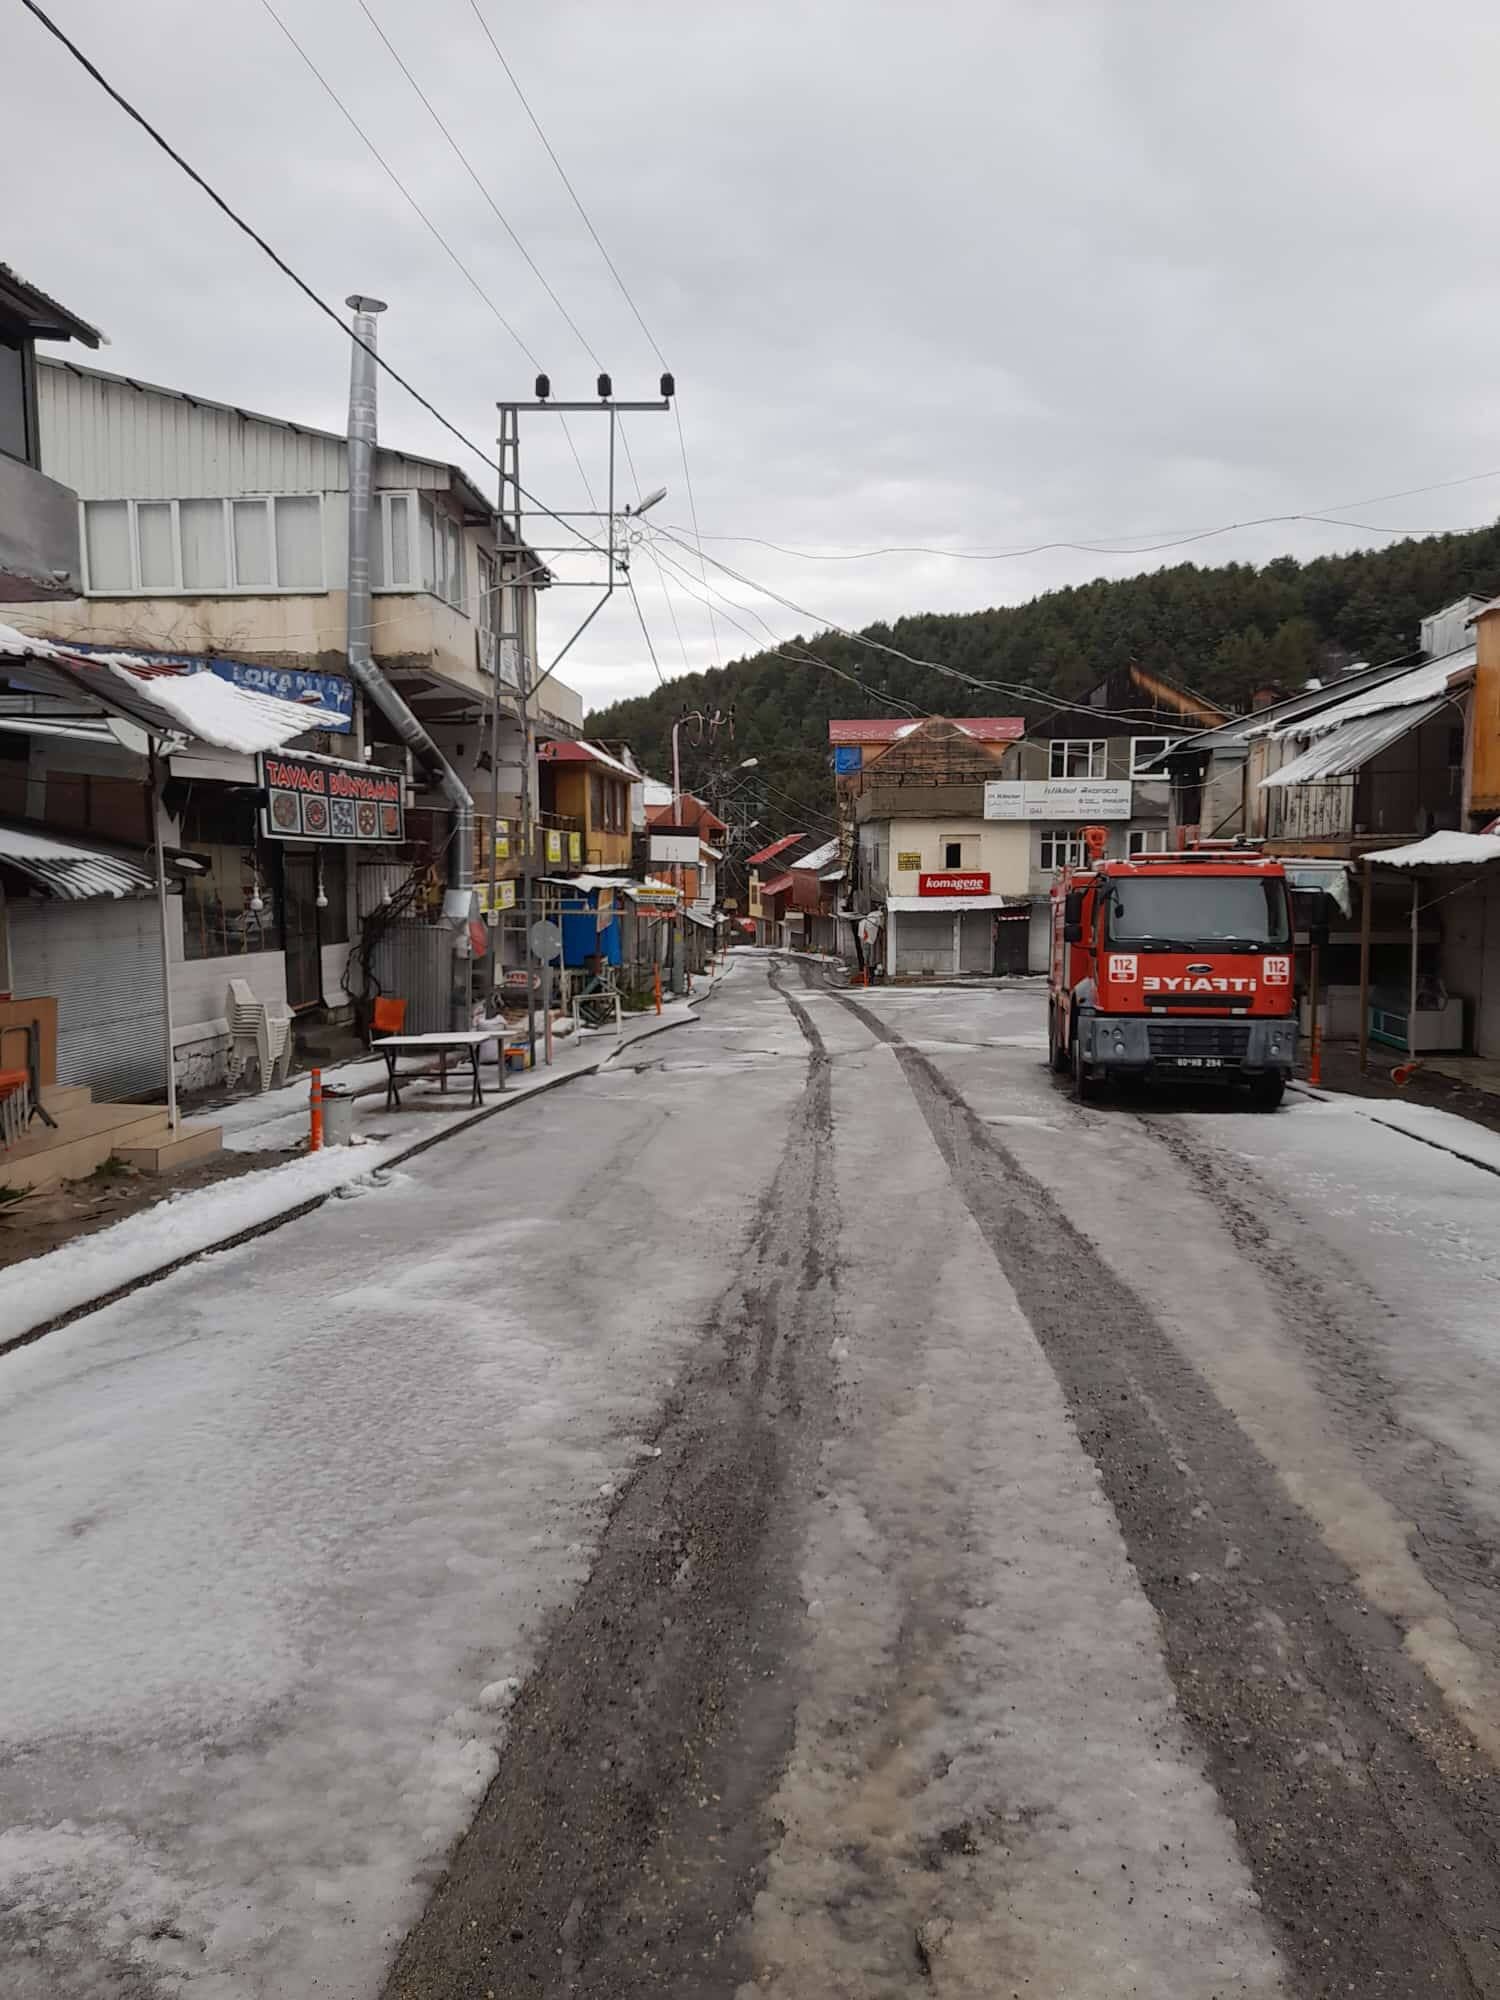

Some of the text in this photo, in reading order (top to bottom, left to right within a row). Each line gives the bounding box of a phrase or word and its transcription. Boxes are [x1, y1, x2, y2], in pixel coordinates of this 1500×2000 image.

[266, 760, 324, 794] TAVACI
[926, 877, 984, 890] komagene
[1114, 959, 1132, 971] 112
[1268, 961, 1286, 973] 112
